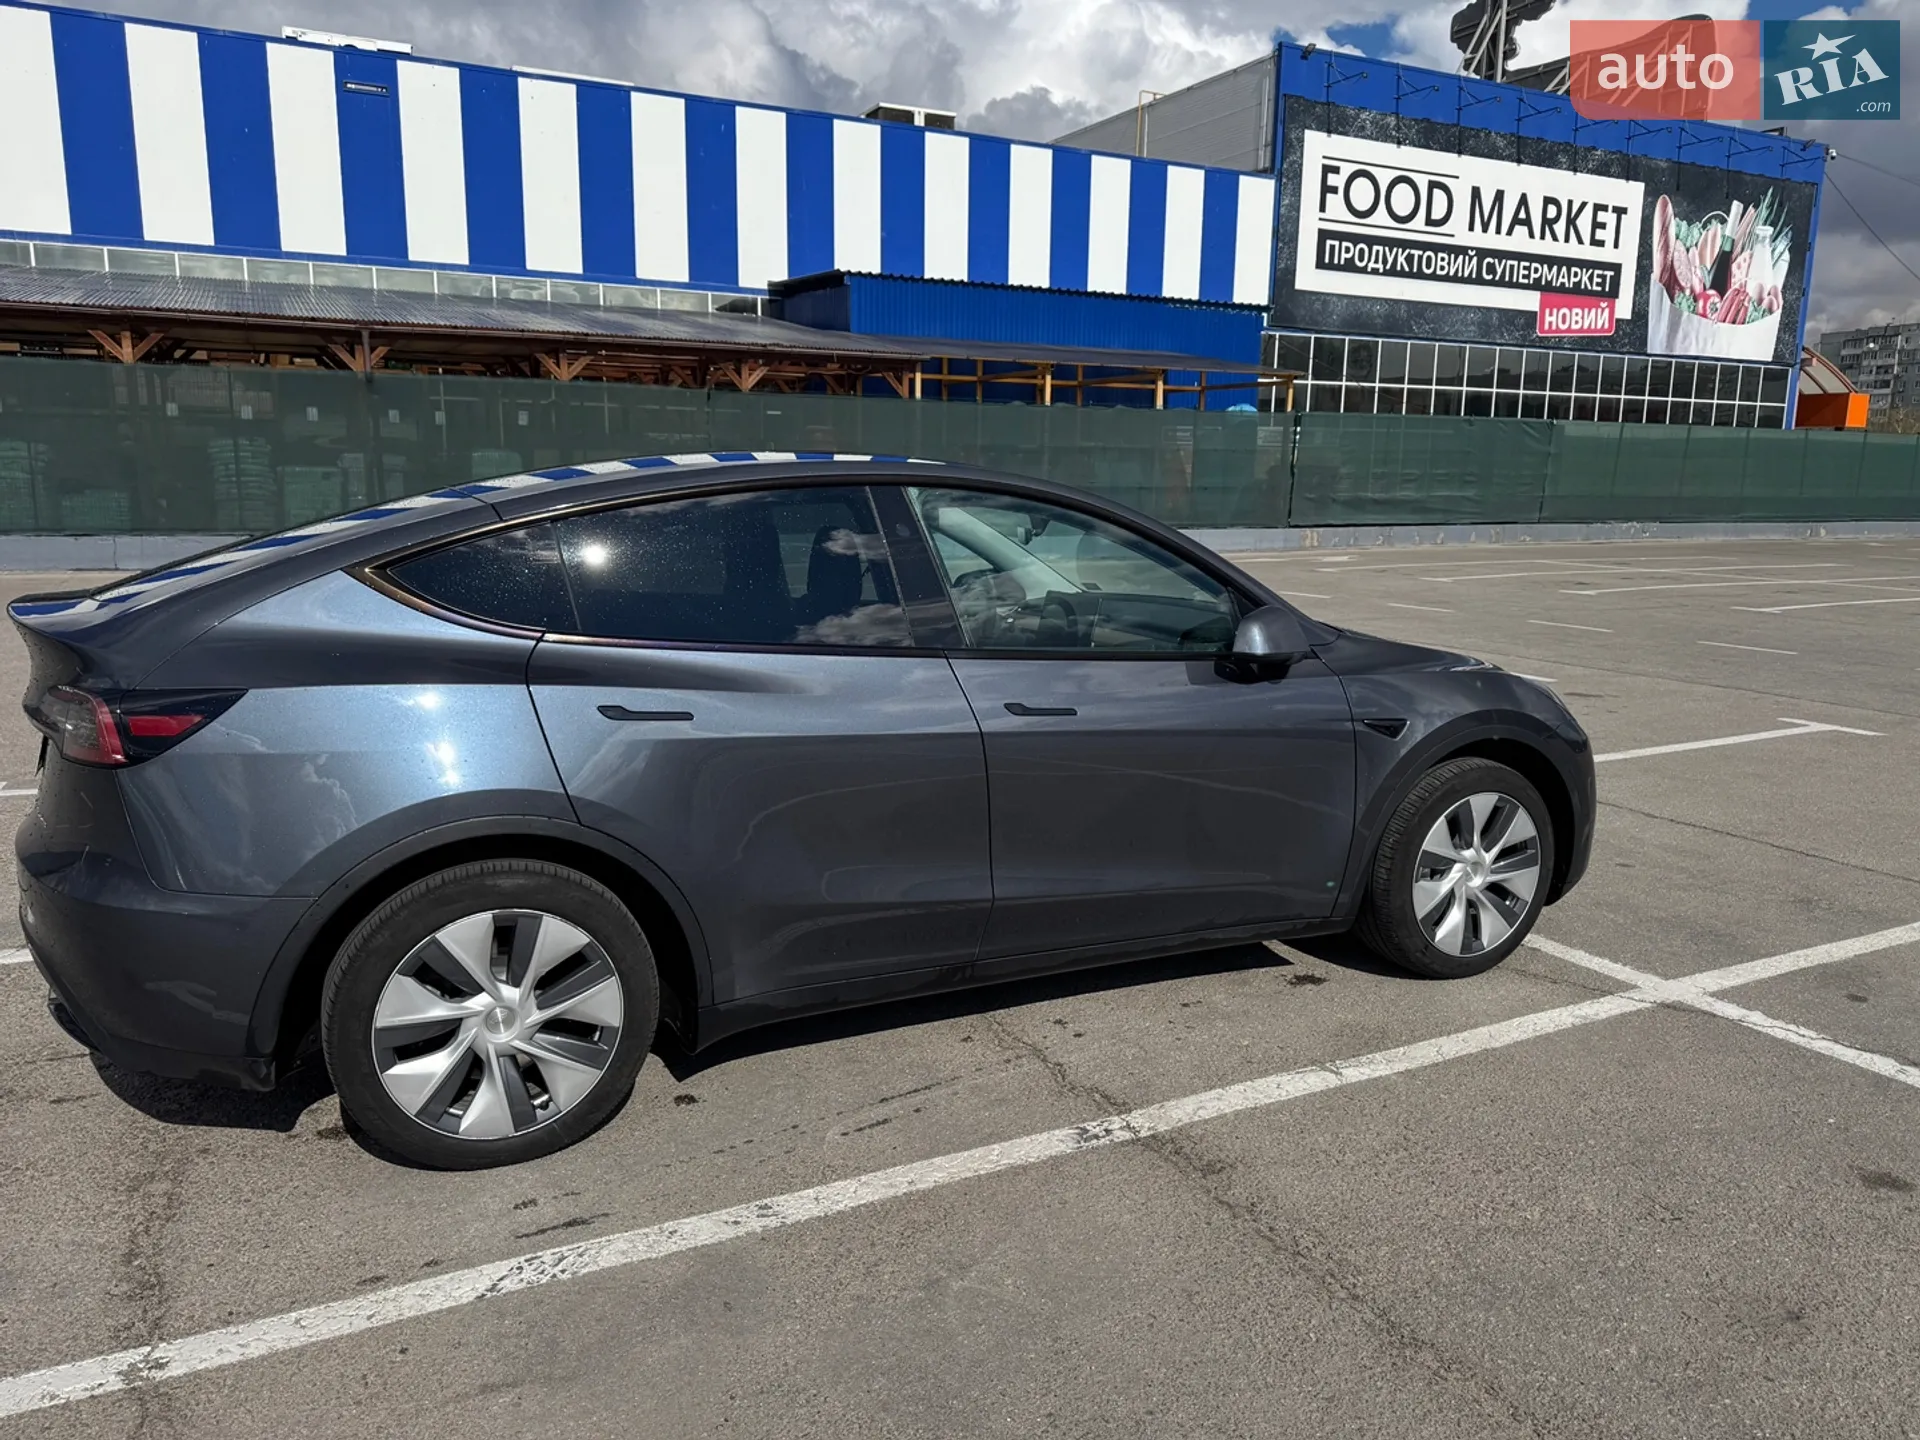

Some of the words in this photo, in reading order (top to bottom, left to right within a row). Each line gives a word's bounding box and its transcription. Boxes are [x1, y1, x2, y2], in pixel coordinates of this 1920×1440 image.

[1318, 163, 1454, 228] FOOD
[1467, 185, 1628, 250] MARKET
[1324, 239, 1477, 279] ПРОДУКТОВИЙ
[1482, 260, 1615, 292] СУПЕРМАРКЕТ
[1544, 301, 1610, 331] НОВИЙ
